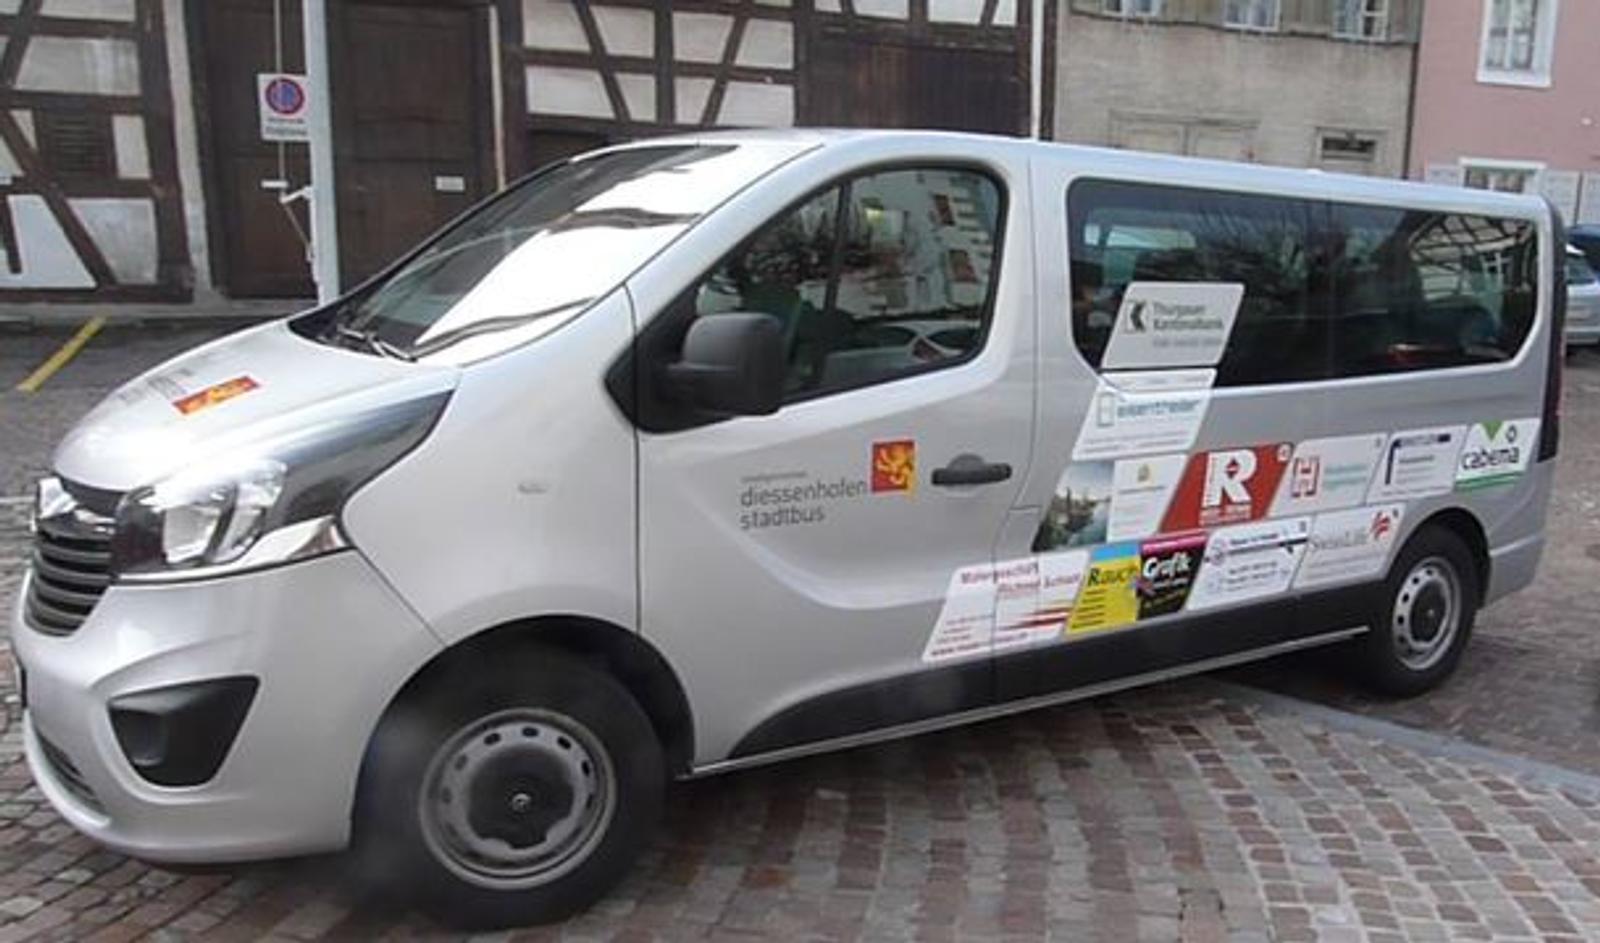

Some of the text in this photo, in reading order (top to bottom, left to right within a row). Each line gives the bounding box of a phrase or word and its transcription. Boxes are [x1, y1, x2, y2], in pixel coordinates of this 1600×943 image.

[1462, 447, 1520, 471] cabema
[740, 476, 867, 507] diessenhofen
[1201, 449, 1256, 507] R
[740, 506, 825, 530] stadtbus
[1143, 552, 1191, 579] Grafik
